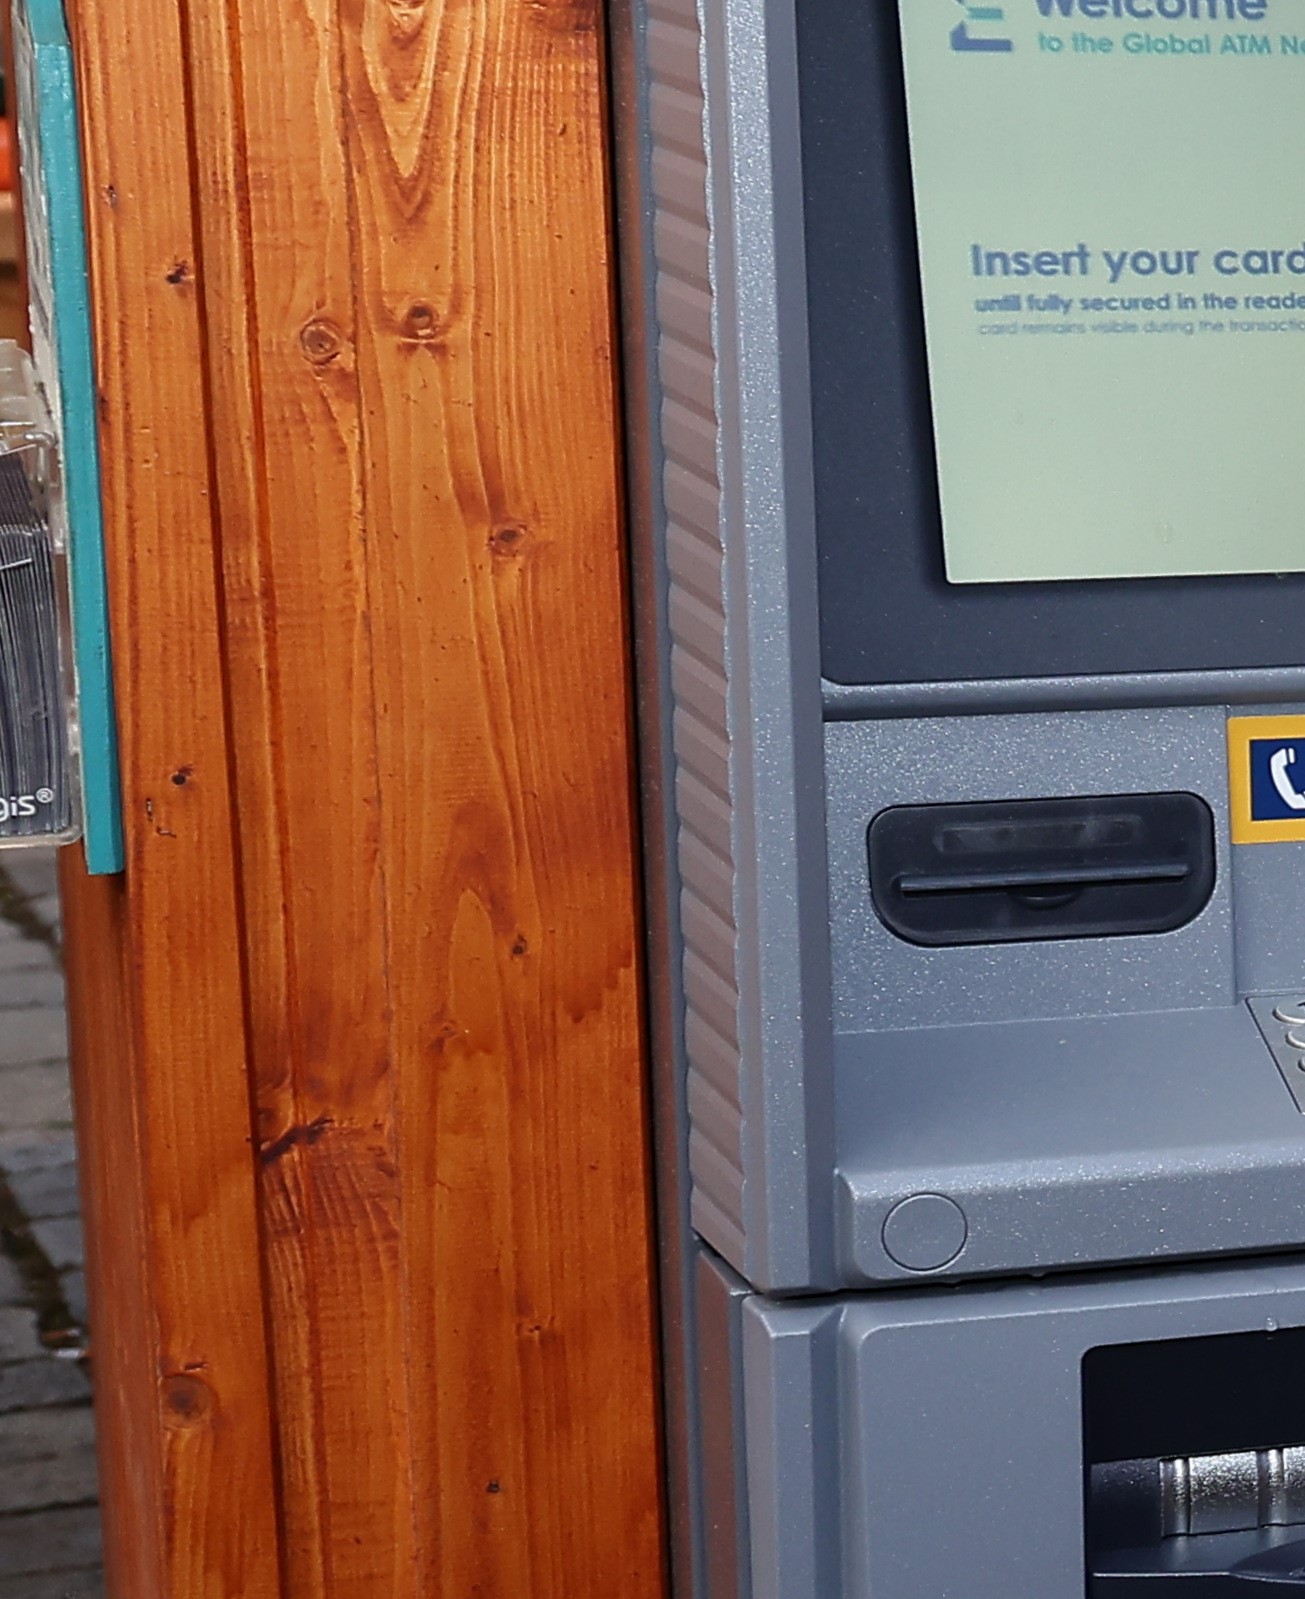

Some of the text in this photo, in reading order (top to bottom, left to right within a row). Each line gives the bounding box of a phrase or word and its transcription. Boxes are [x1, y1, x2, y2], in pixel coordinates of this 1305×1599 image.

[1037, 31, 1064, 53] to
[1072, 32, 1114, 54] the
[1122, 33, 1211, 56] Global
[1220, 34, 1273, 57] ATM
[970, 243, 1091, 277] Insert
[1102, 249, 1200, 284] your
[1027, 293, 1073, 315] fully
[1079, 293, 1171, 312] secured
[1176, 292, 1197, 311] in
[1203, 292, 1239, 311] the
